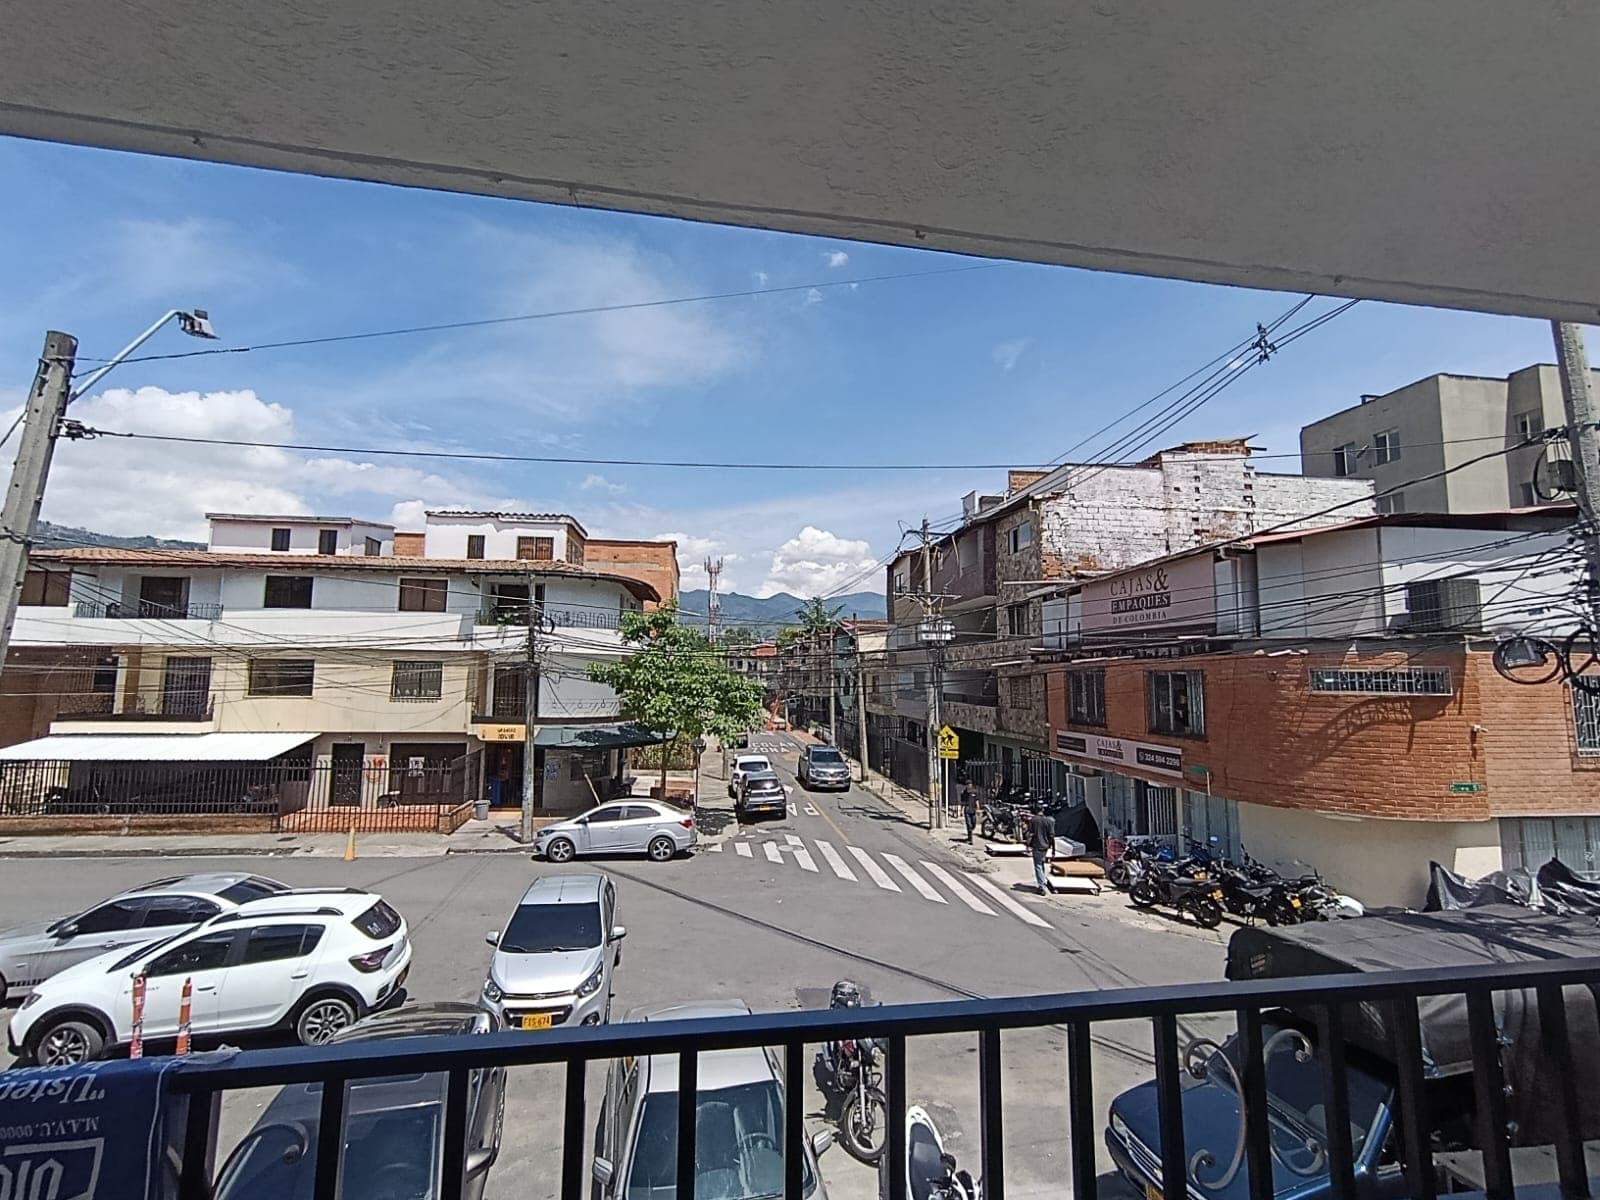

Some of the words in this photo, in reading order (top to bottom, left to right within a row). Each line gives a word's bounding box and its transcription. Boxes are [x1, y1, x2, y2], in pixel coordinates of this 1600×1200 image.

[1112, 593, 1169, 613] EMPAQUES
[1113, 616, 1121, 624] DE
[1125, 610, 1167, 623] COLOMBIA
[786, 802, 820, 817] PA
